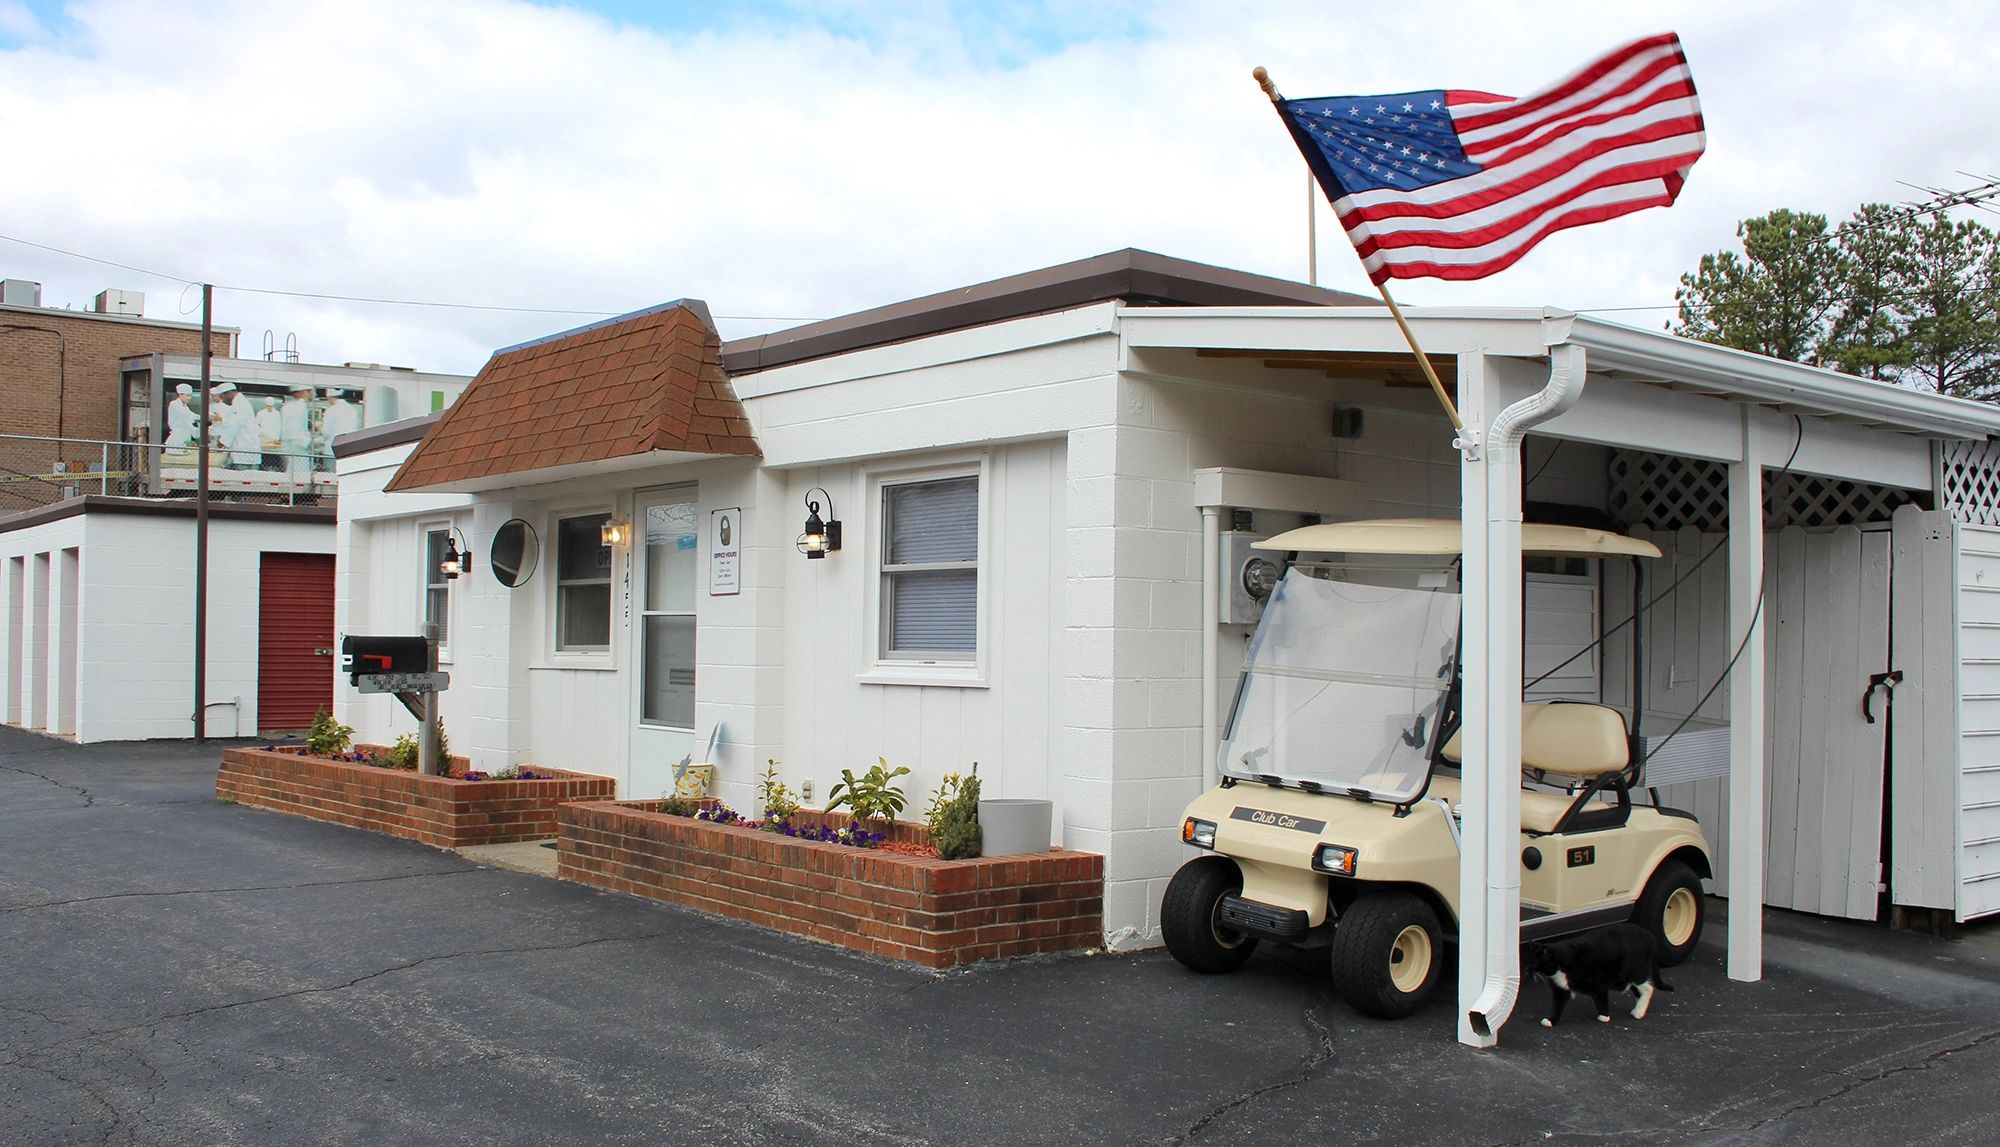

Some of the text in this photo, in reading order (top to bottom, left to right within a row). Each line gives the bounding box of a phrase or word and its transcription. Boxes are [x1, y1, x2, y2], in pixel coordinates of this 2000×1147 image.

[1252, 811, 1300, 828] Club Car
[1574, 850, 1590, 863] 51
